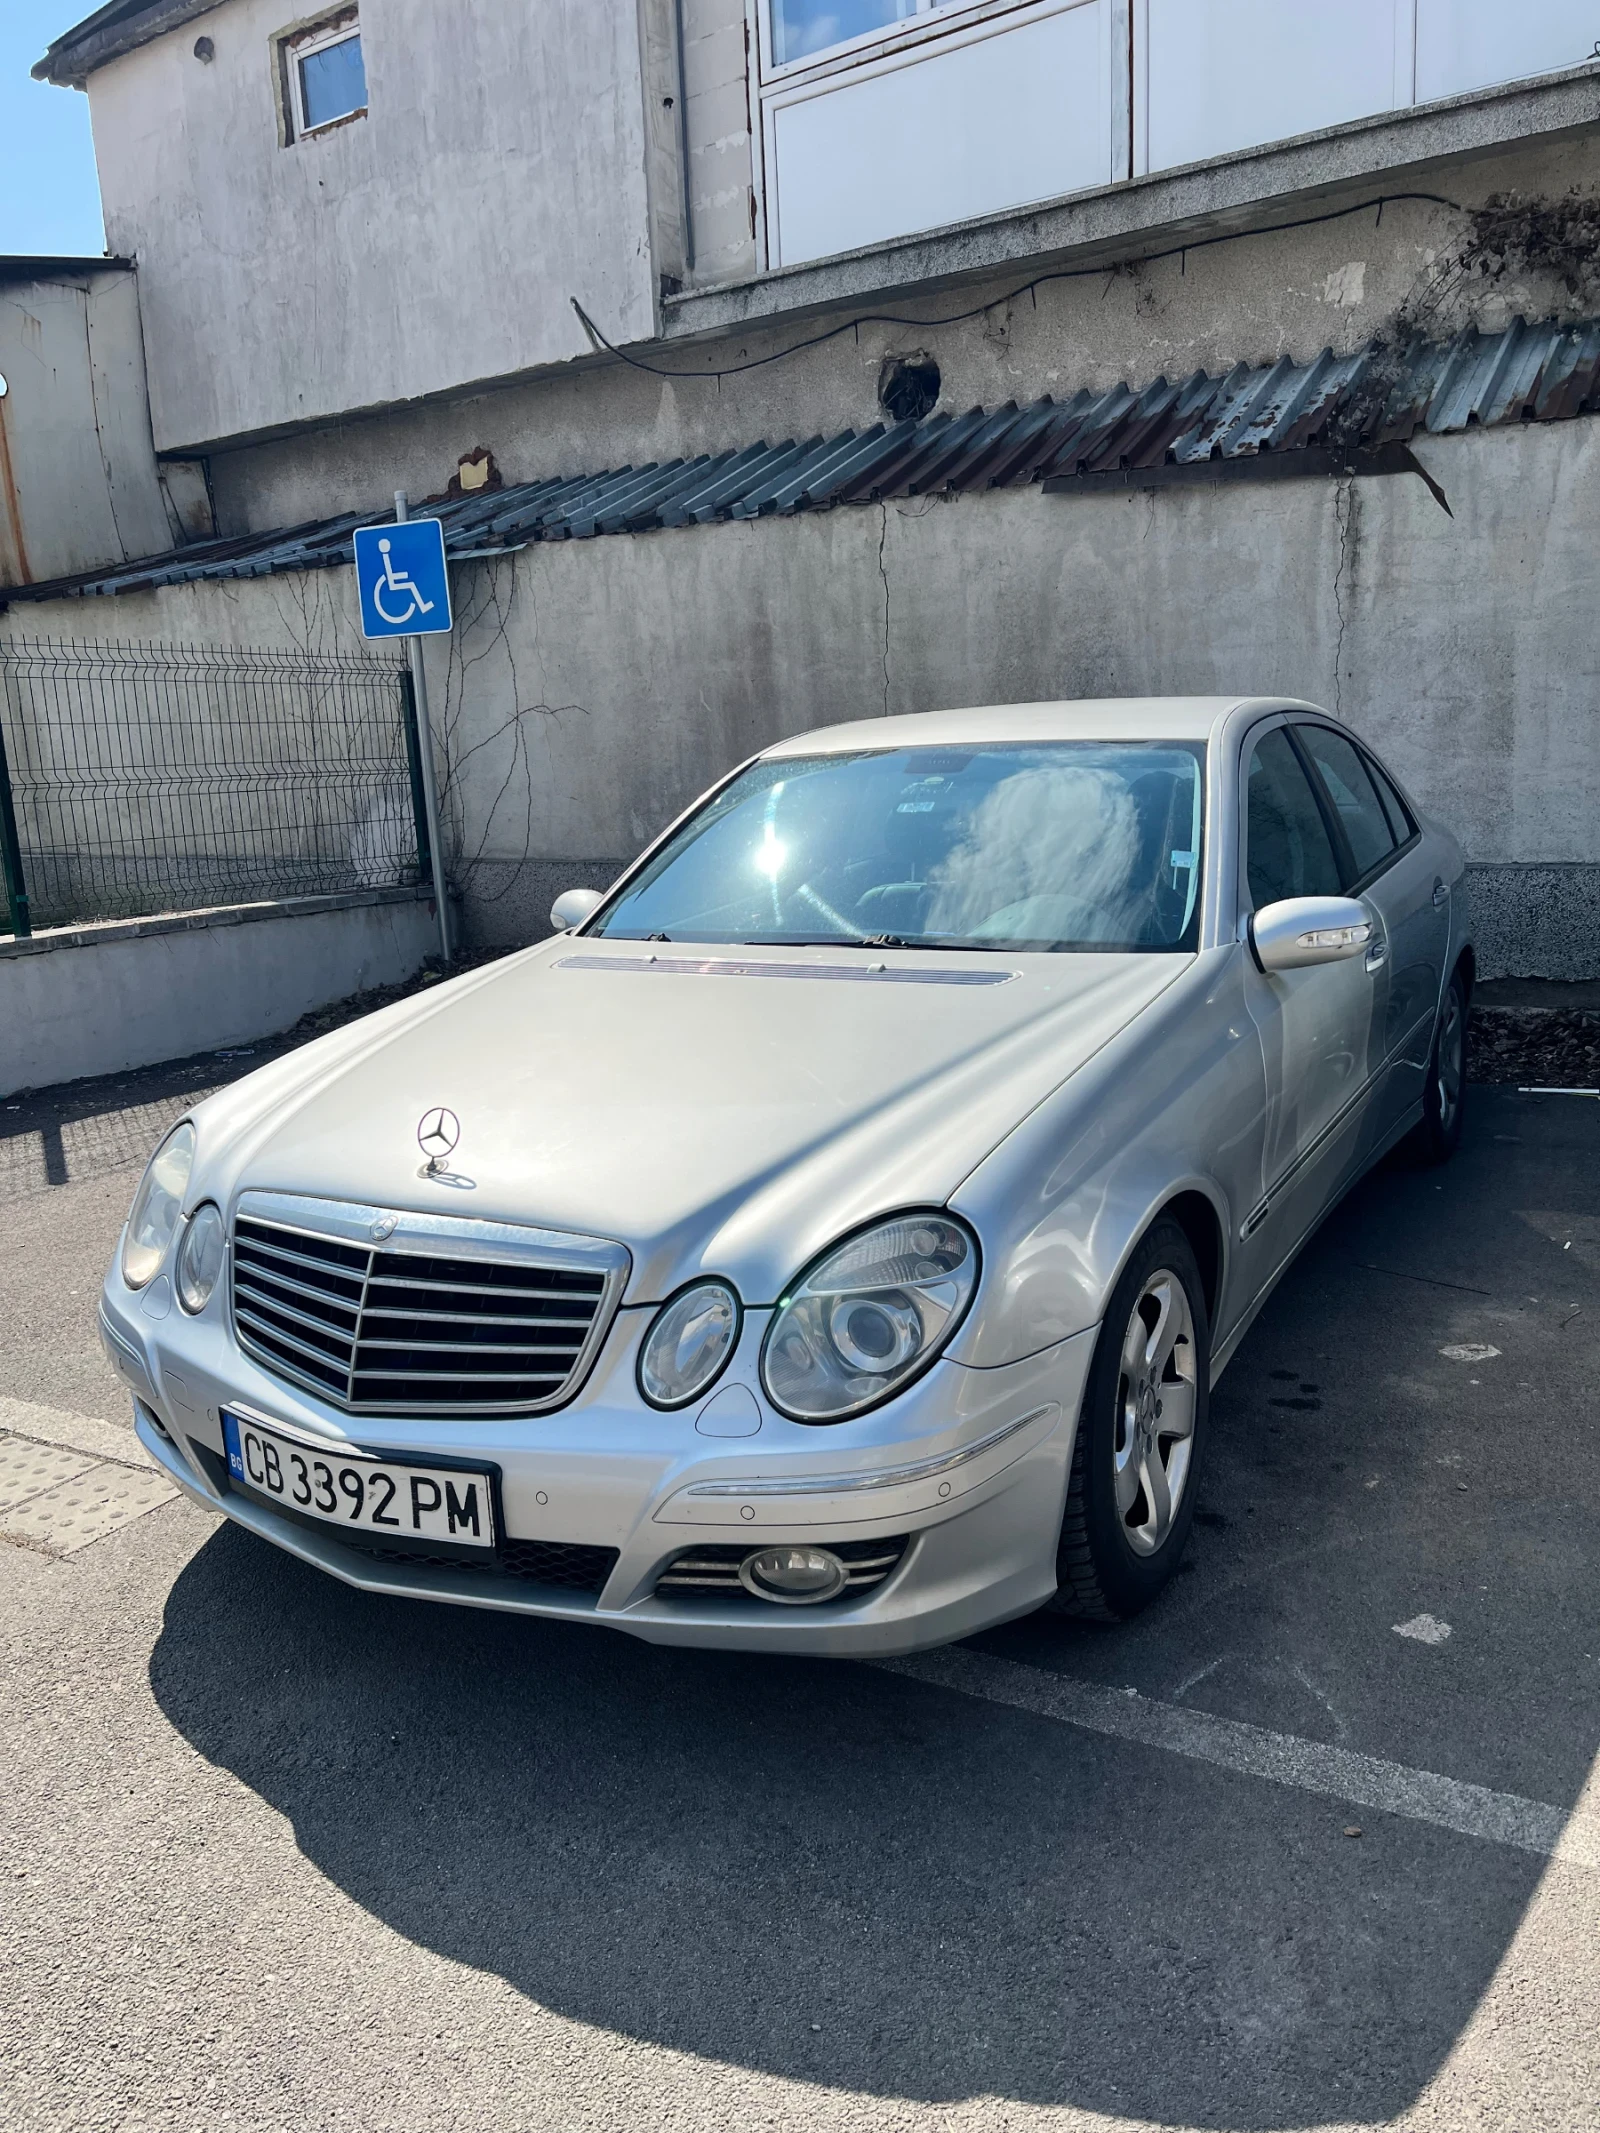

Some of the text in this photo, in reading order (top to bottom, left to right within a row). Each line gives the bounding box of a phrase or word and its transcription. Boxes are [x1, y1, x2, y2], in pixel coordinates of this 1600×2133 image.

[230, 1452, 243, 1471] BG
[244, 1432, 481, 1537] CB 3392 PM
